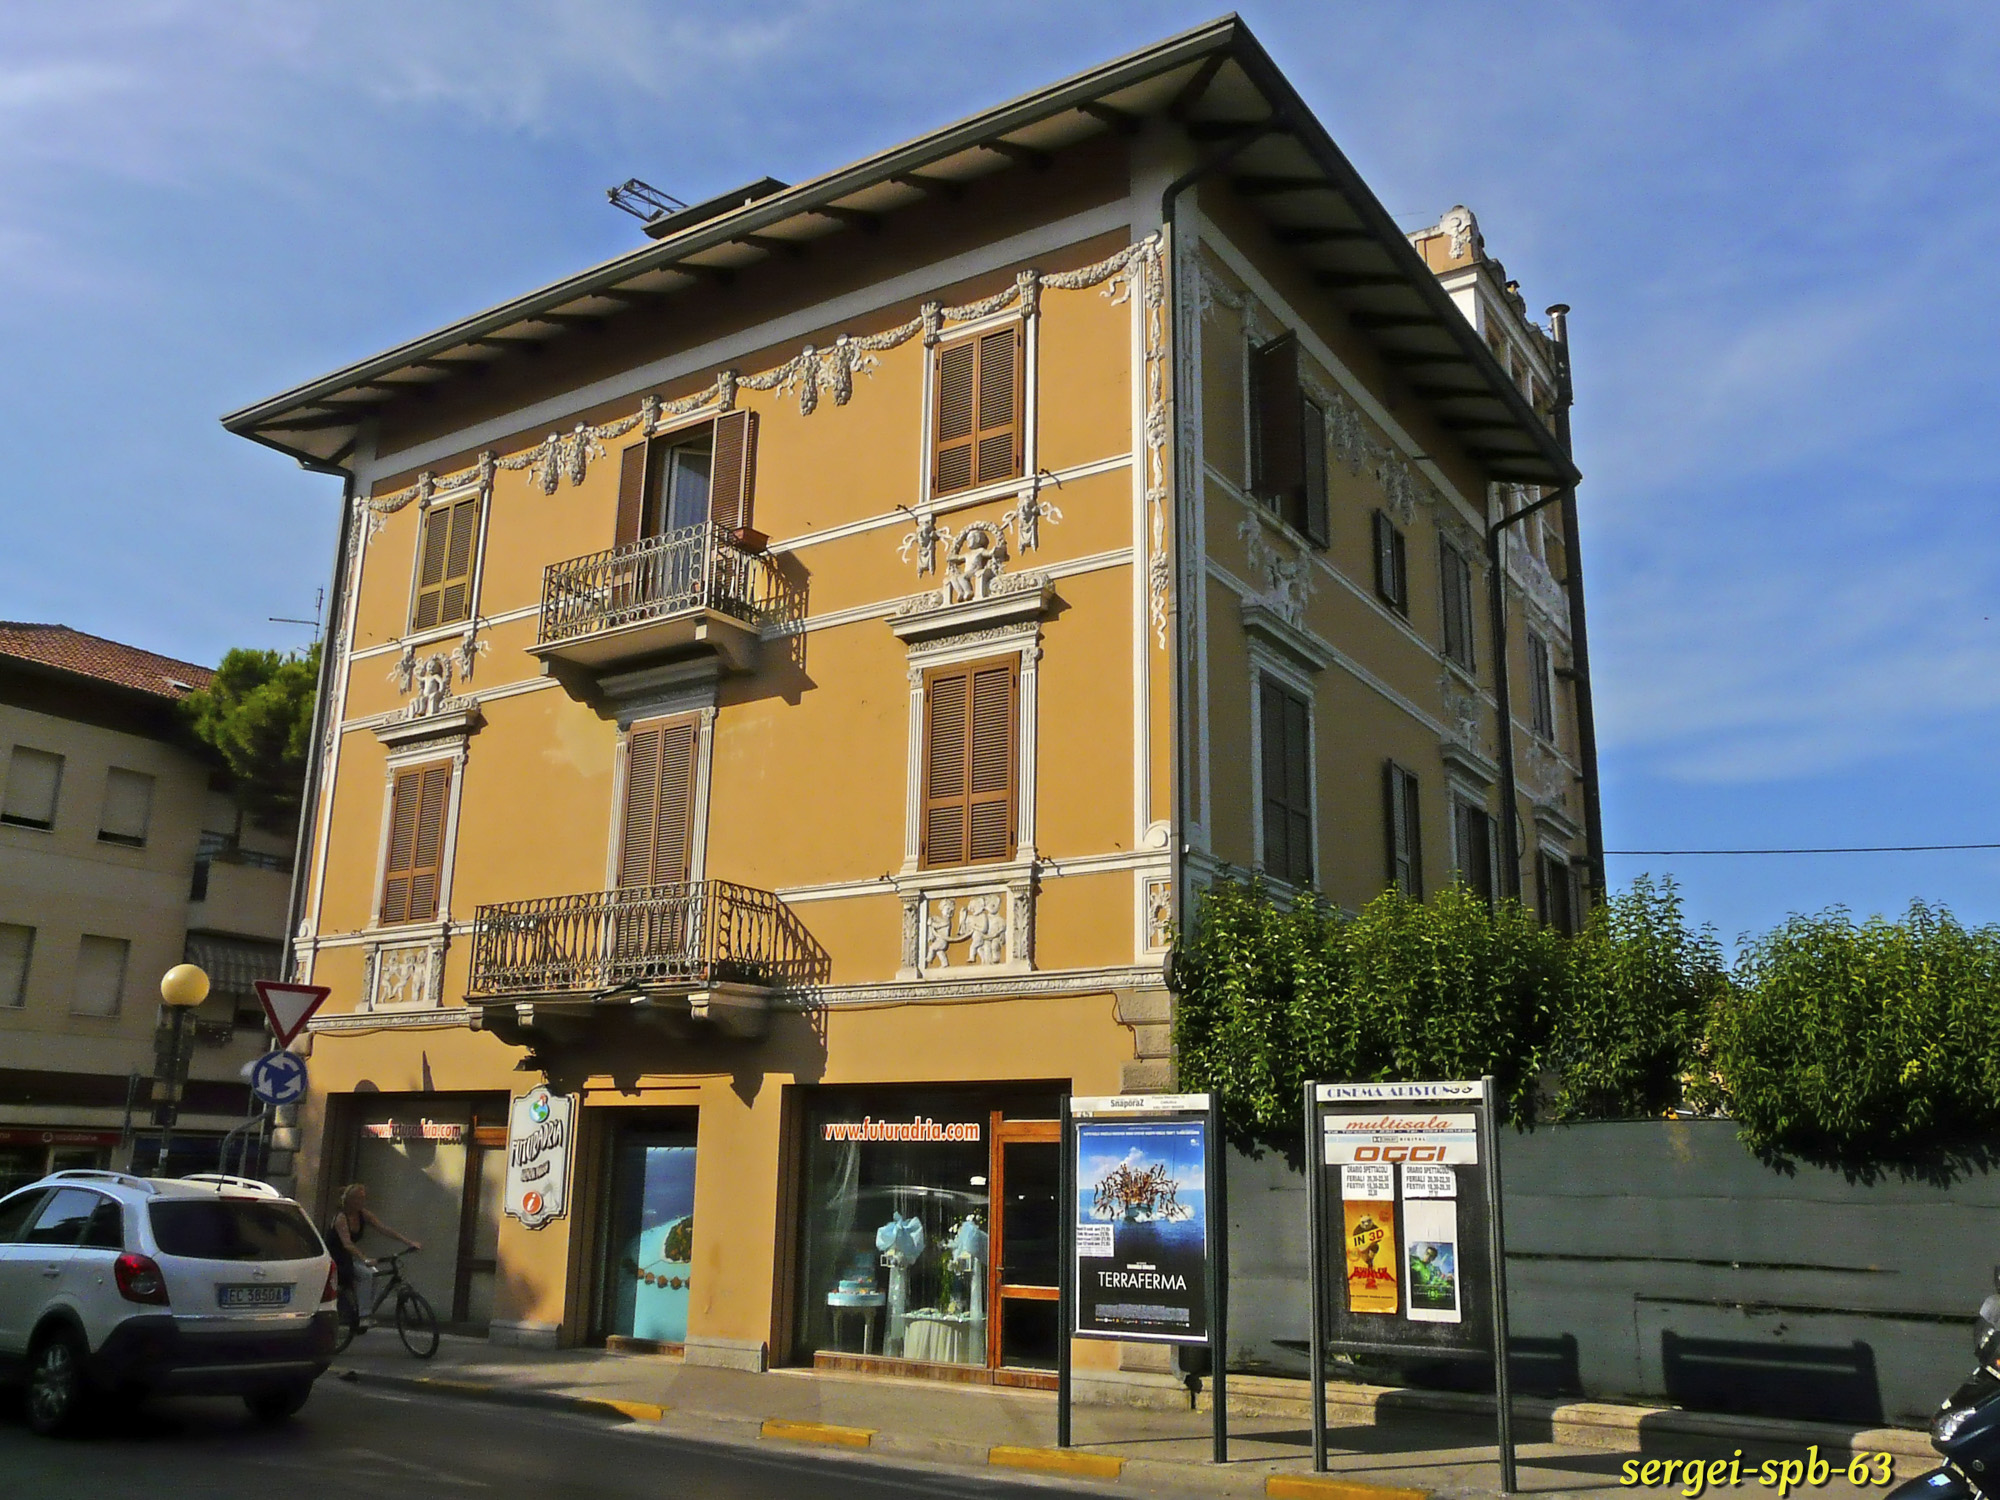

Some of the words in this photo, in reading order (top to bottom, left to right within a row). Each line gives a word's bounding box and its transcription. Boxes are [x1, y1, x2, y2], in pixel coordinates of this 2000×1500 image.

[1327, 1086, 1383, 1098] CINEMA
[820, 1115, 980, 1142] www.futuradria.com
[1345, 1115, 1453, 1130] multisala
[1353, 1146, 1447, 1162] OGGI
[1406, 1175, 1425, 1183] FERIALI
[1353, 1234, 1366, 1247] IN
[1369, 1229, 1385, 1242] 3D
[1097, 1271, 1187, 1291] TERRAFERMA
